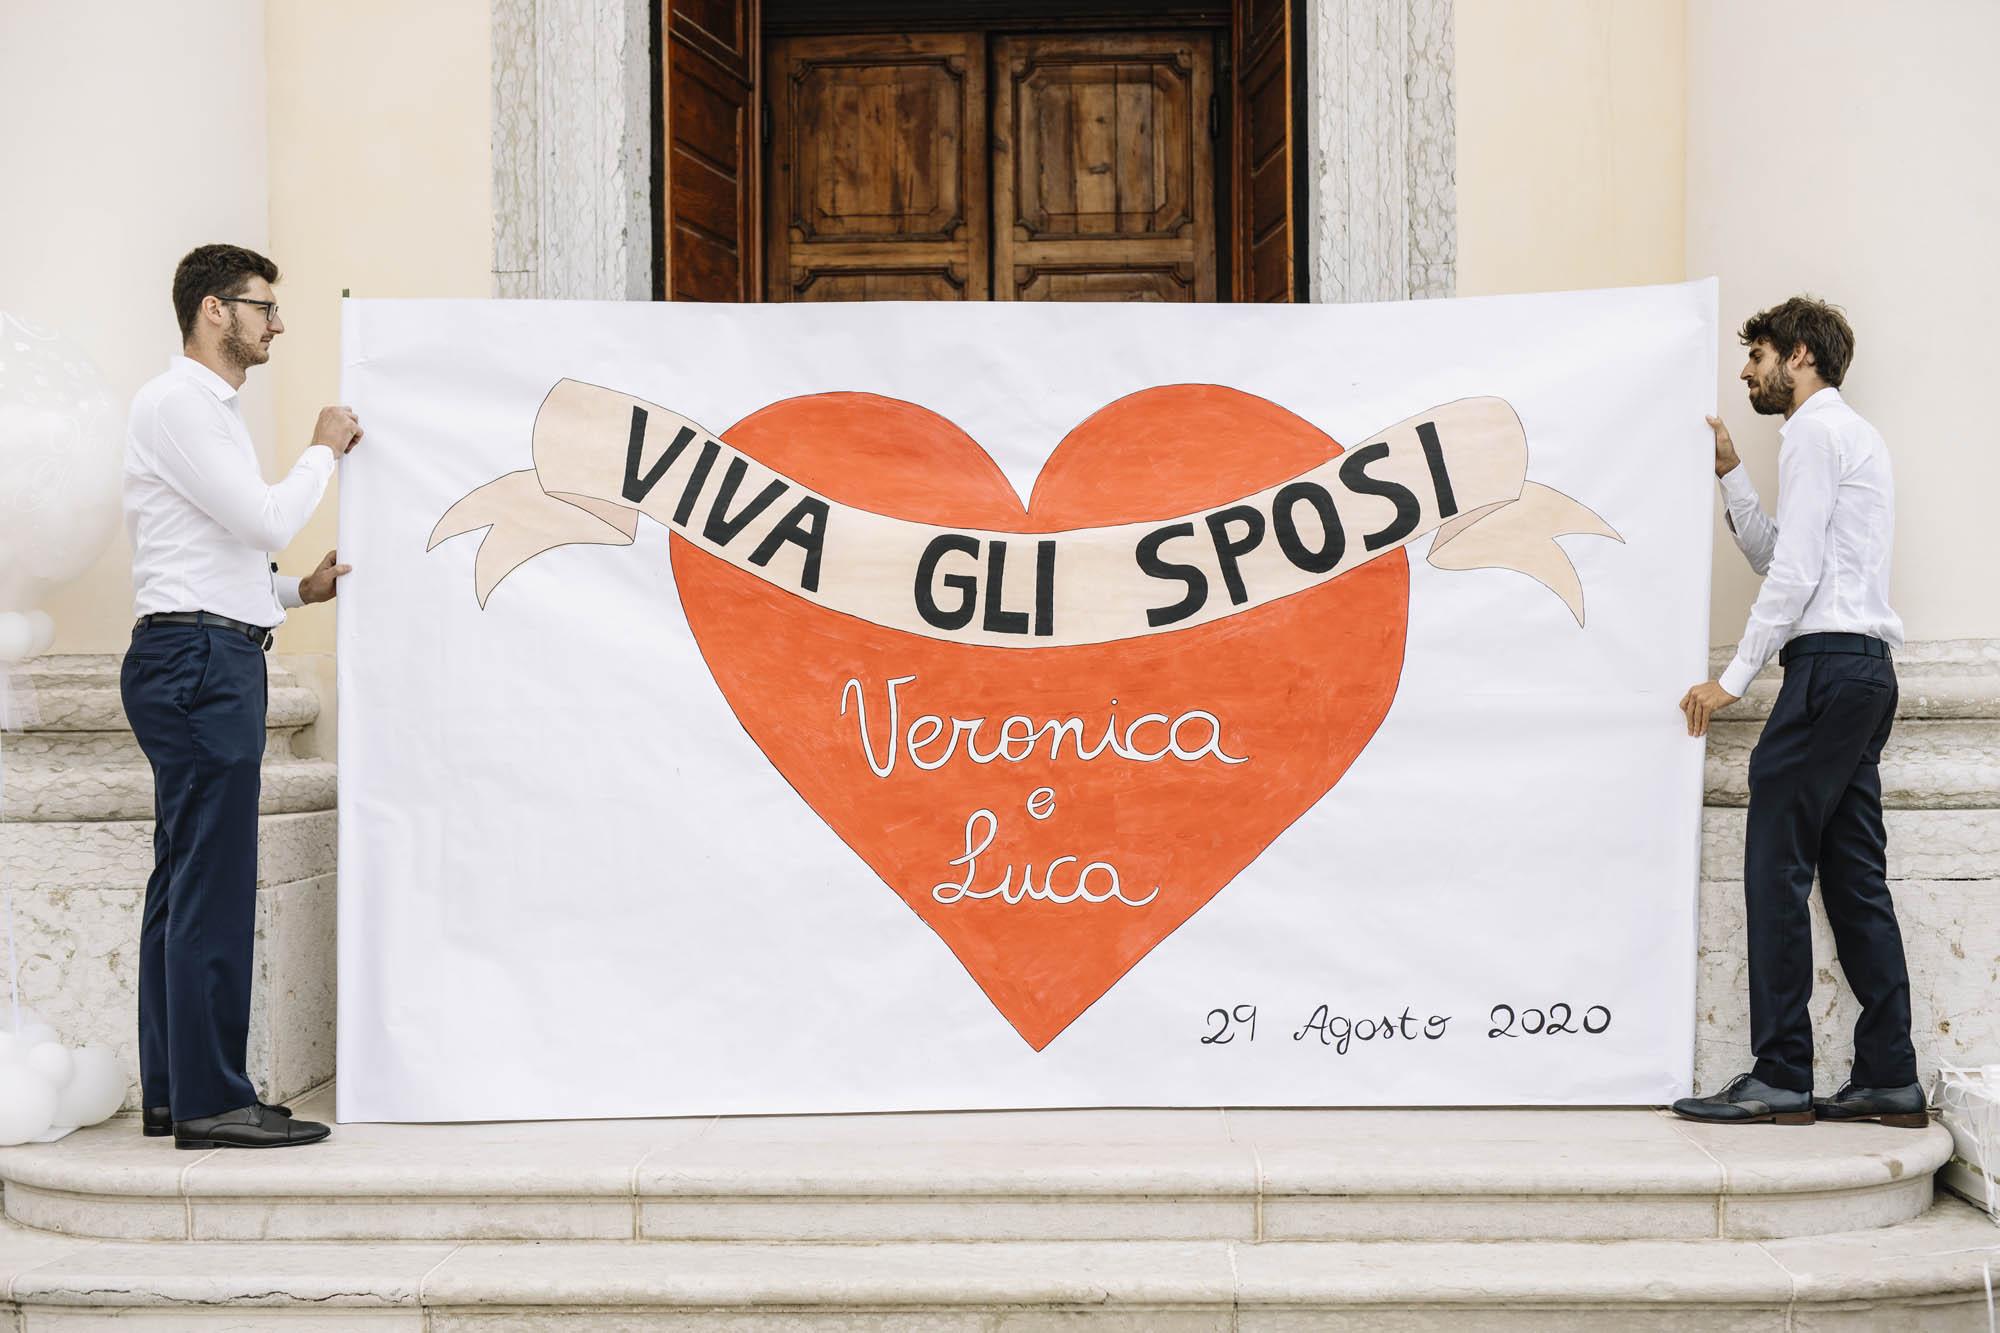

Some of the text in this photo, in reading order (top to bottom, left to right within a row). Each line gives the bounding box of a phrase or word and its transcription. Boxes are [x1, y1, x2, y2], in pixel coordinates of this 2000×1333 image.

[621, 405, 1459, 637] VIVA GLI SPOSI
[840, 674, 1250, 778] Veronica
[1026, 787, 1056, 820] e
[932, 808, 1160, 907] Luca
[1200, 1002, 1613, 1056] 29 Agosto 2020
